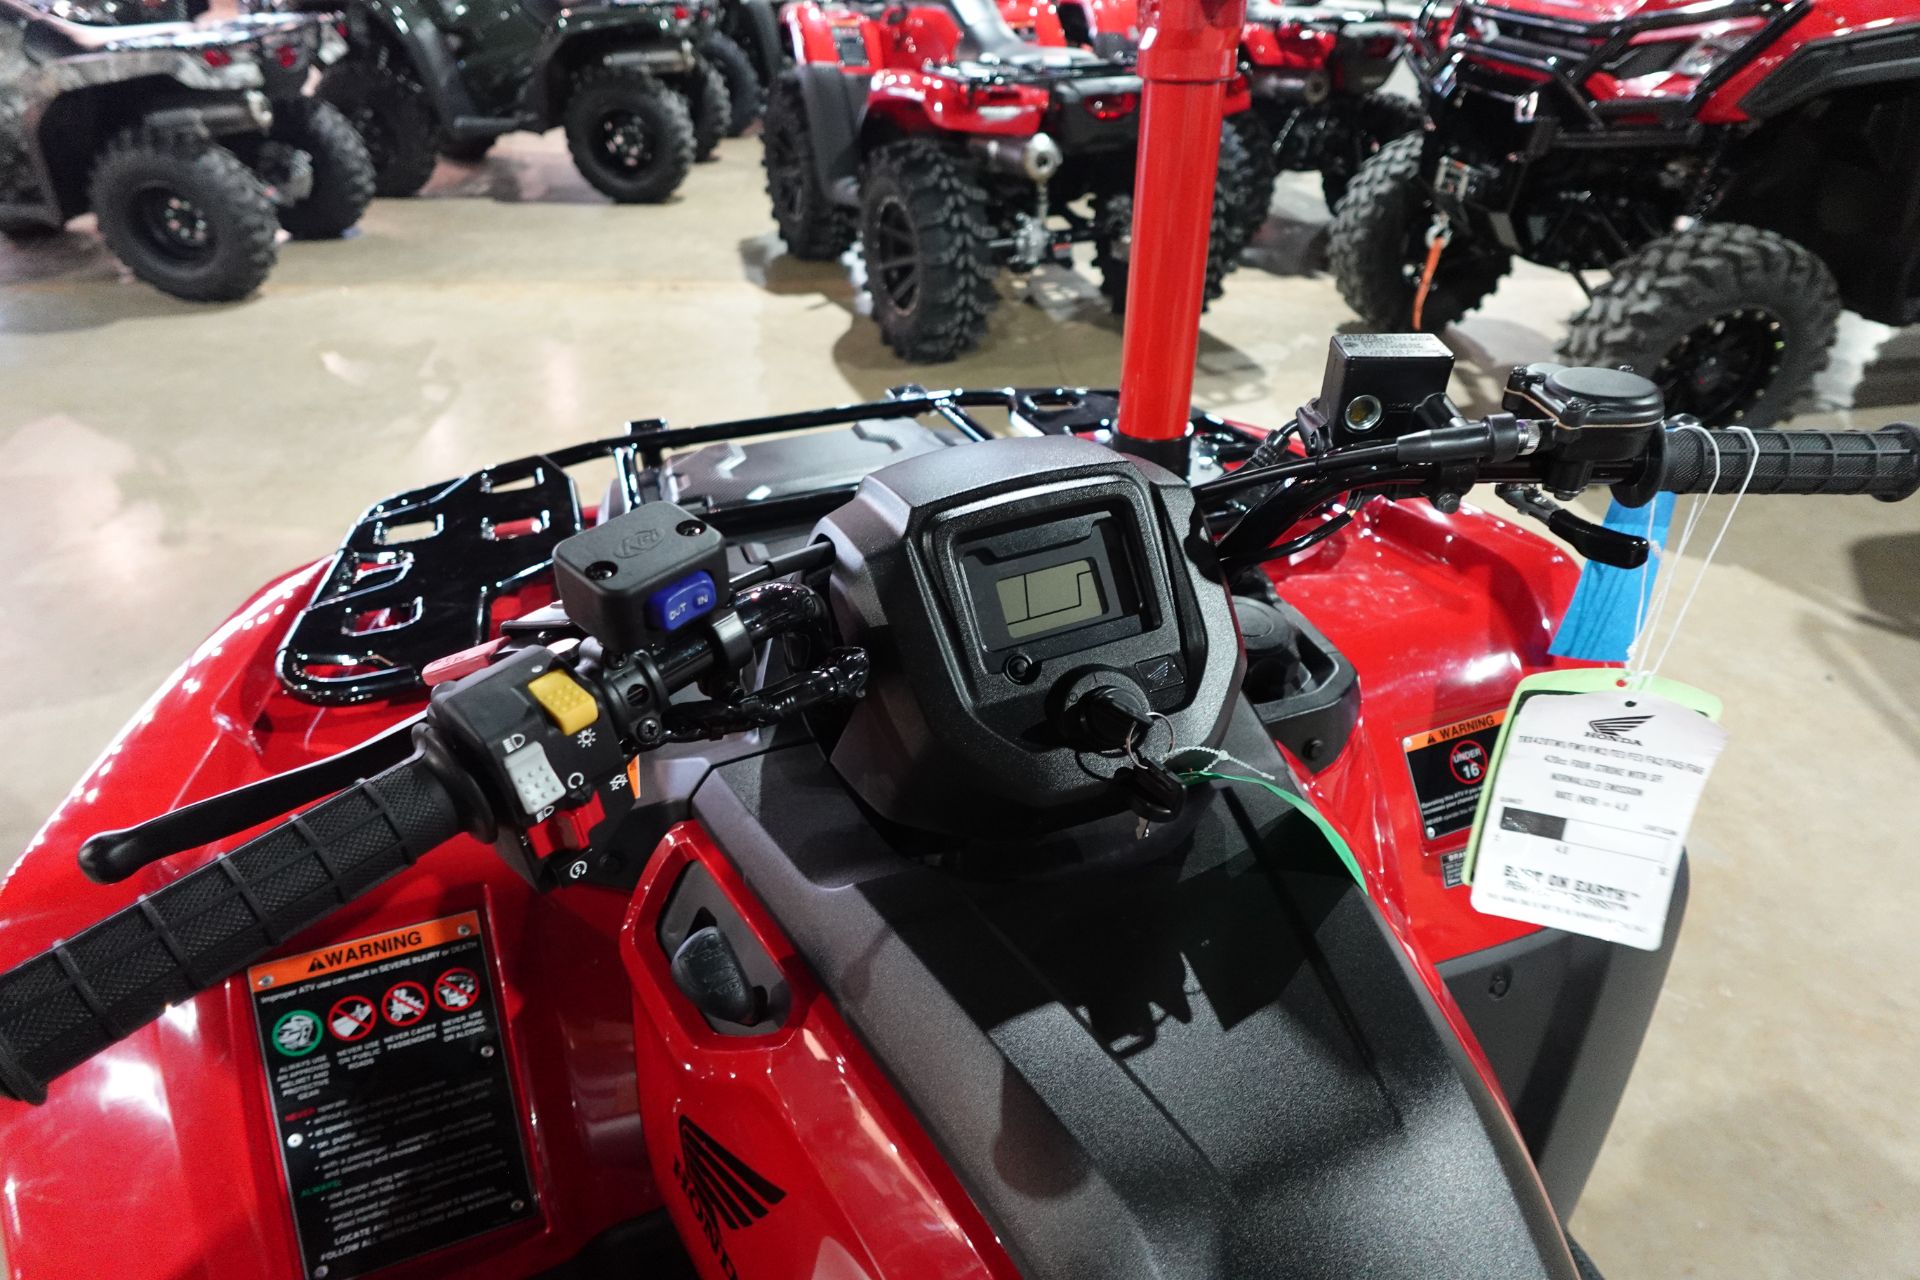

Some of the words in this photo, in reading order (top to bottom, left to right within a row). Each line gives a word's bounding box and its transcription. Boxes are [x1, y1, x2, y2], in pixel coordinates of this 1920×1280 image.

[669, 602, 687, 620] OUT
[697, 594, 709, 605] IN
[1440, 715, 1495, 739] WARNING
[1584, 731, 1643, 746] HONDA
[1453, 748, 1482, 763] UNDER
[1463, 765, 1480, 778] 16
[324, 931, 422, 967] WARNING
[378, 958, 411, 971] SEVERE
